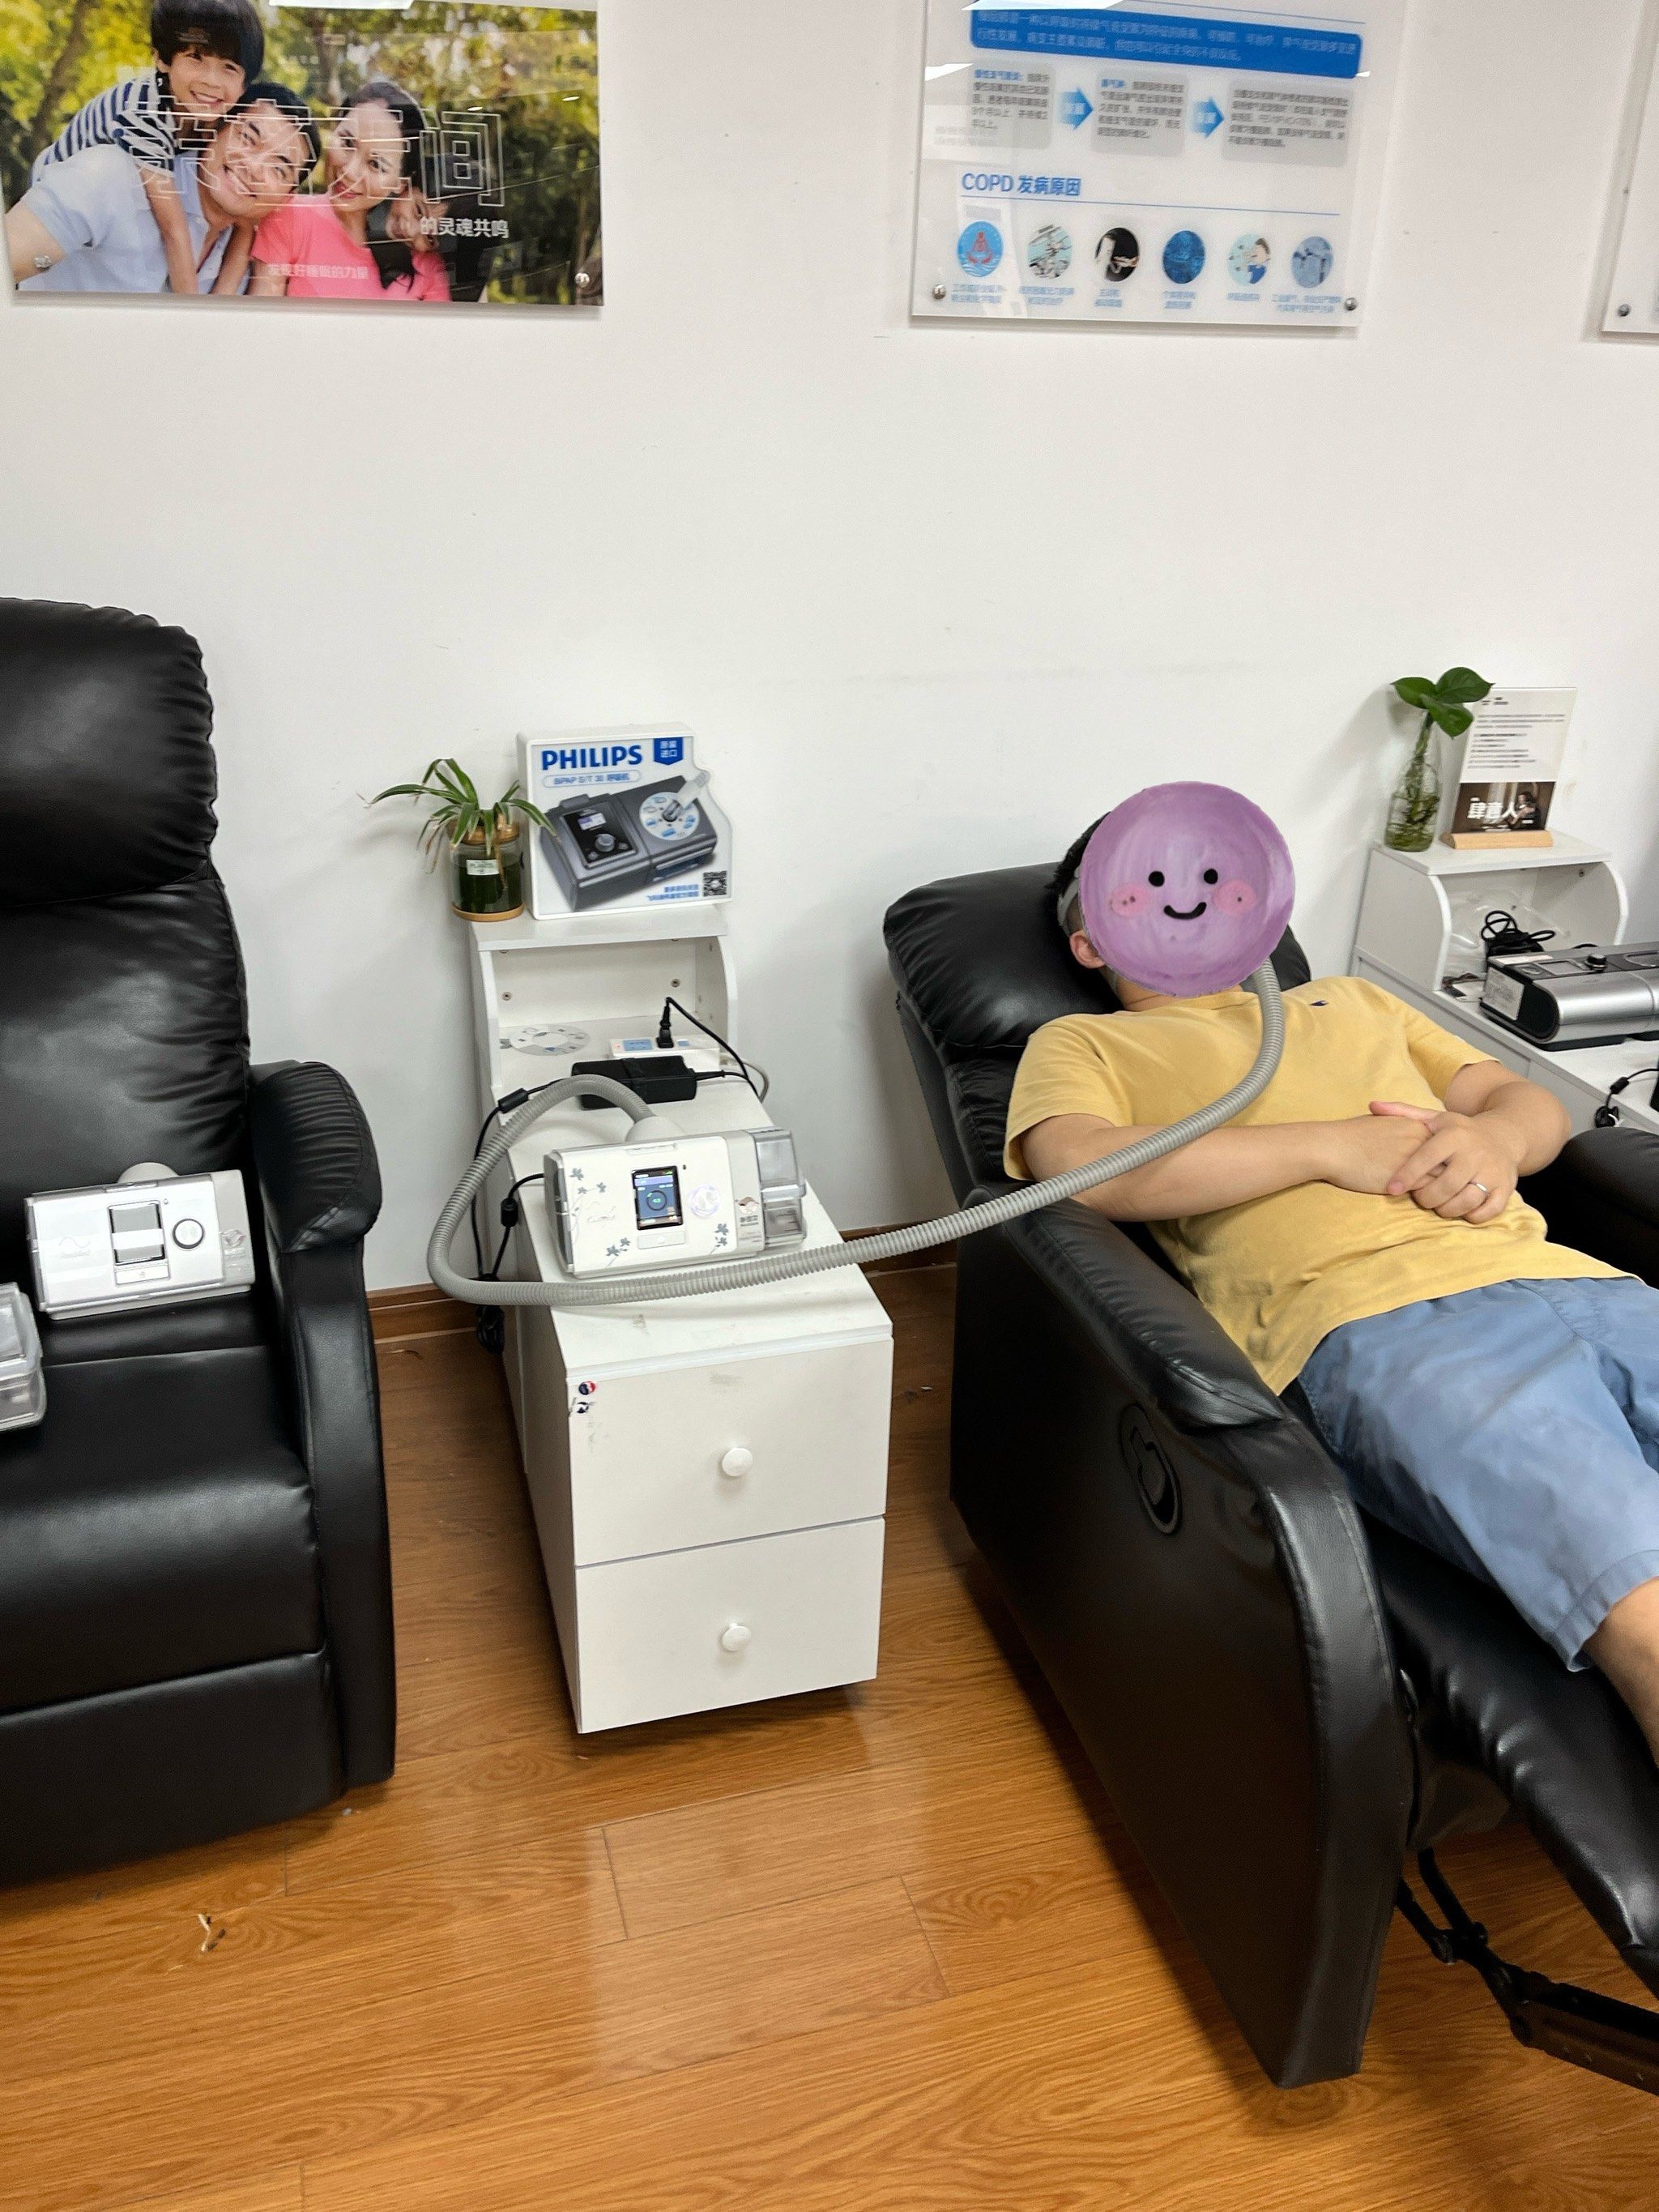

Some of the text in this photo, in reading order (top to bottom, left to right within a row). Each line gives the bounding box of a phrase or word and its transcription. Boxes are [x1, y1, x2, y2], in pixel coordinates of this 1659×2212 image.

[962, 173, 1081, 196] COPD 发病原因
[420, 216, 509, 239] 的灵魂共鸣
[541, 745, 643, 771] PHILIPS
